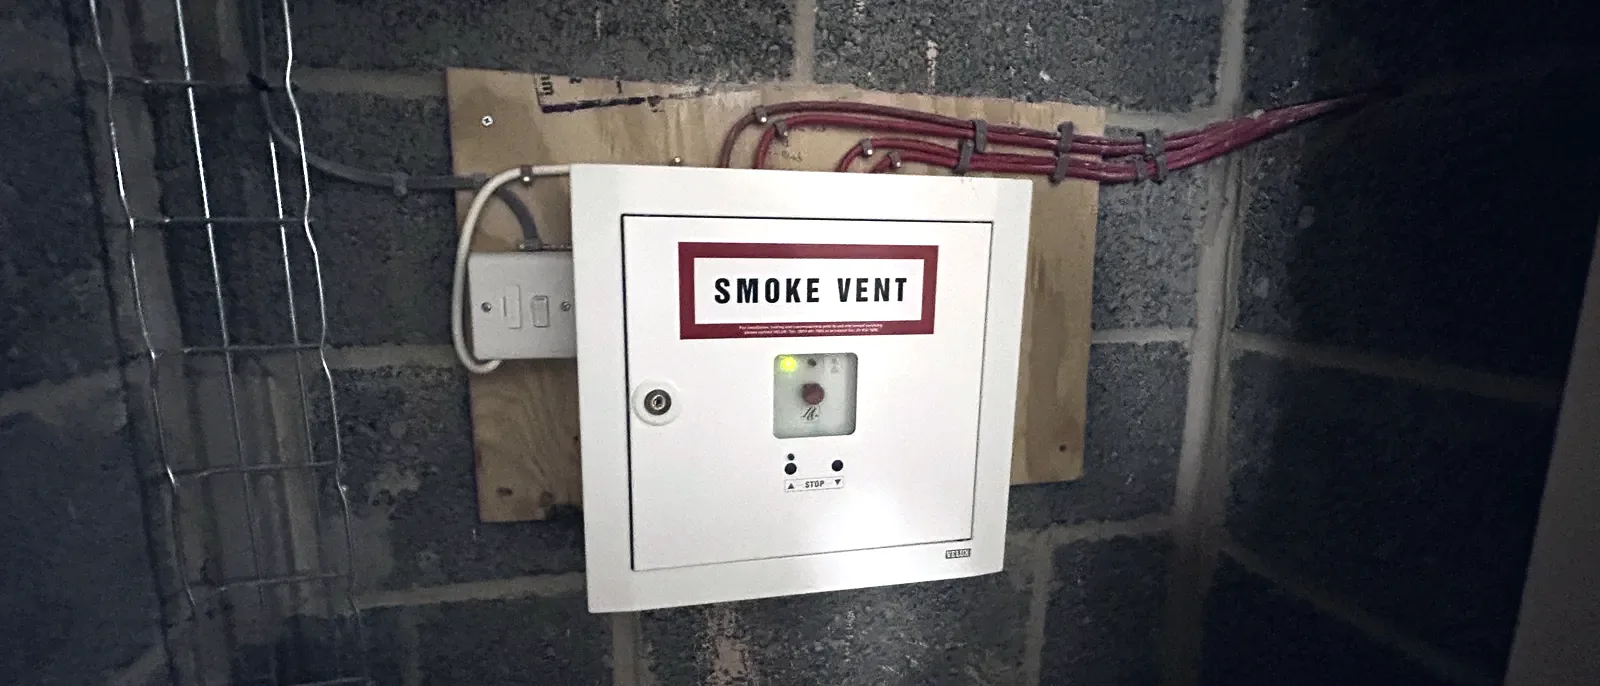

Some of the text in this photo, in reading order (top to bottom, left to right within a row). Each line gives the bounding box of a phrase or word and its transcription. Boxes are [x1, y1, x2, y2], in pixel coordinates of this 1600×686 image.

[714, 277, 908, 304] SMOKE VENT
[804, 480, 825, 489] STOP
[946, 549, 970, 559] VELUX
